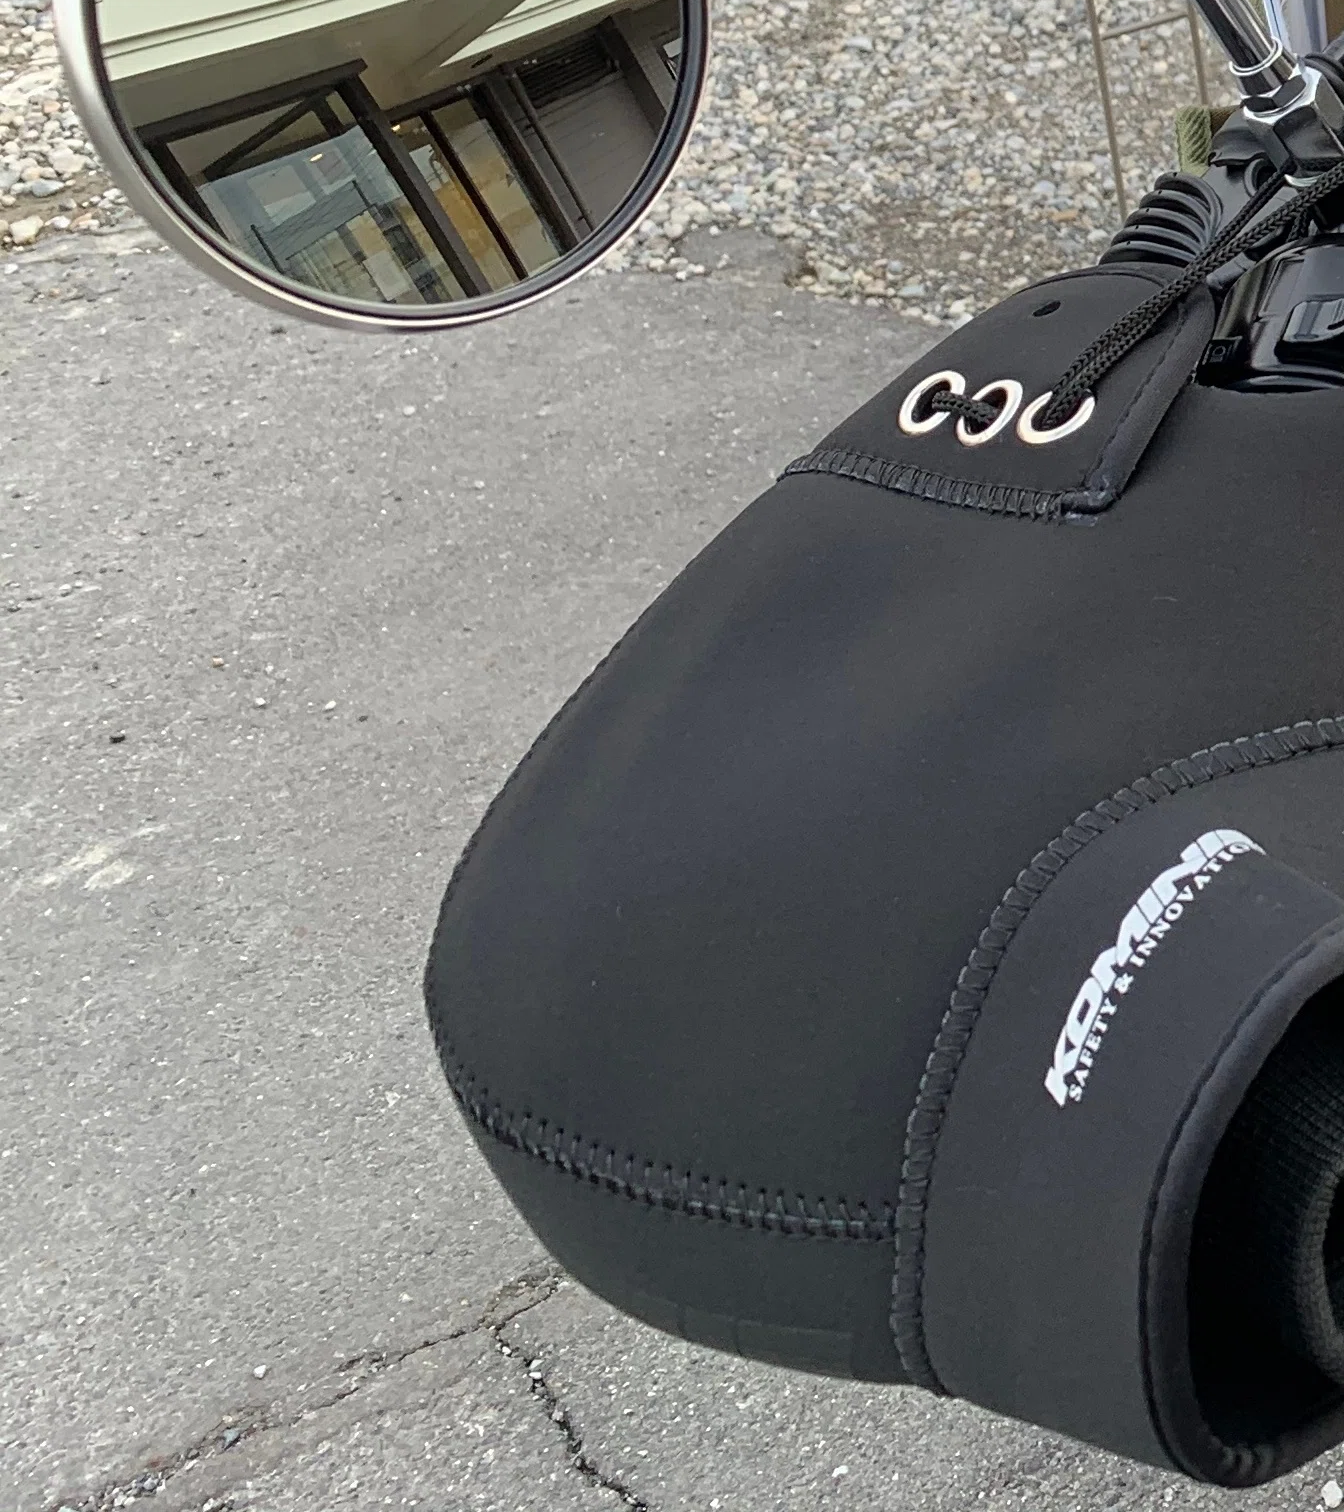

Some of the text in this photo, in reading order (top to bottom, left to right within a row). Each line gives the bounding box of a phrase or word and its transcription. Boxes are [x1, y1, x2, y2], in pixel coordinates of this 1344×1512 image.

[1068, 841, 1251, 1103] SAFETY & INNOVATIO
